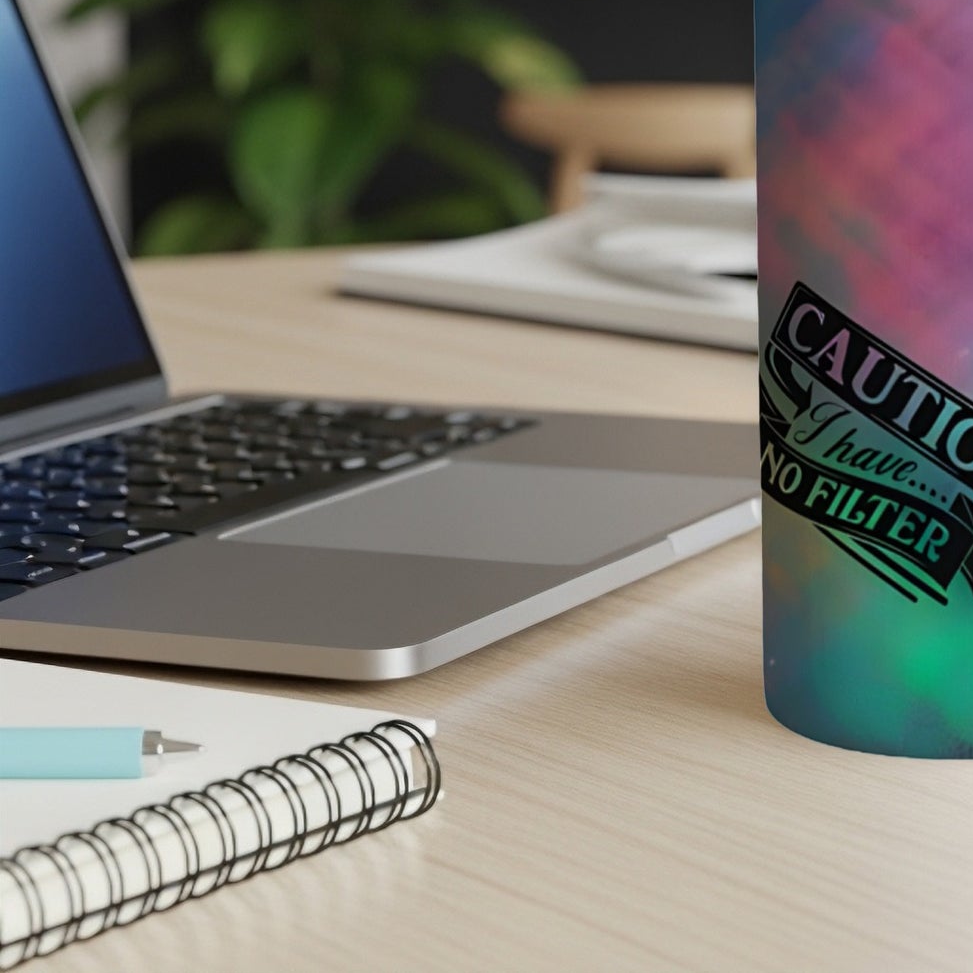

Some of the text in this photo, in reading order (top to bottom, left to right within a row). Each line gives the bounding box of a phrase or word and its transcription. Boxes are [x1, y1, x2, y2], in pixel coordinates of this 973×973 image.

[795, 401, 852, 447] I
[761, 440, 950, 563] NO FILTER
